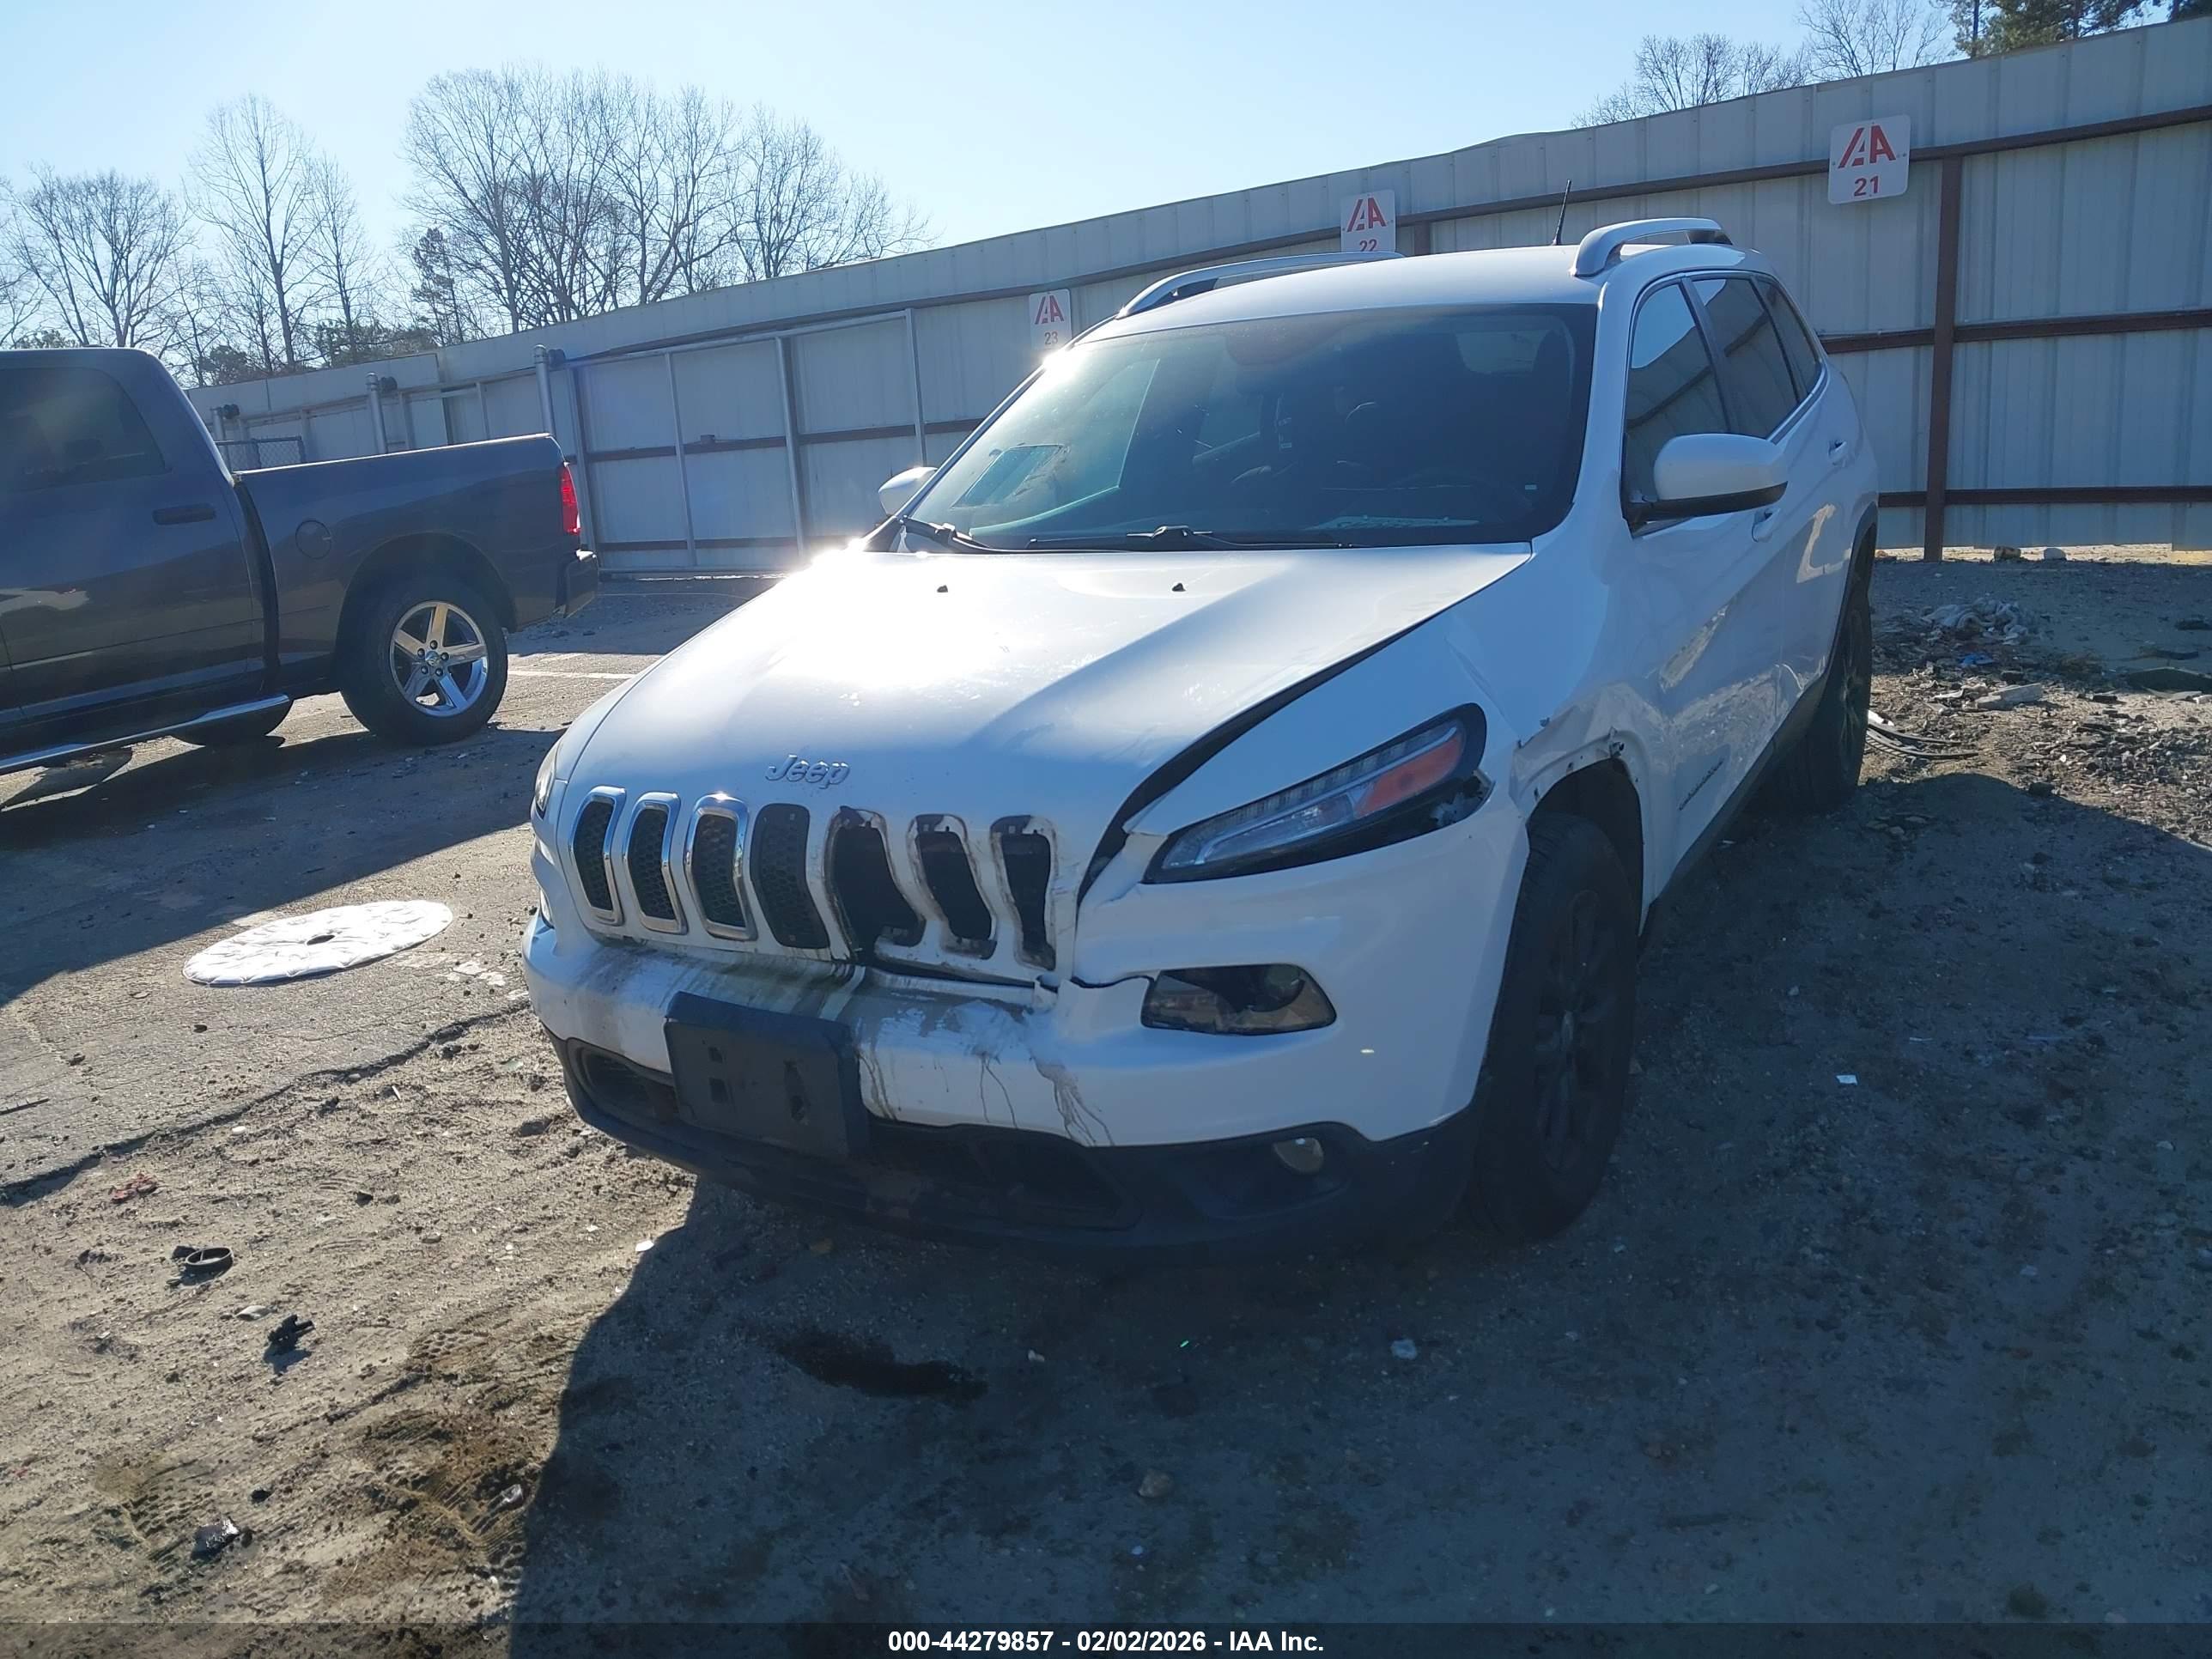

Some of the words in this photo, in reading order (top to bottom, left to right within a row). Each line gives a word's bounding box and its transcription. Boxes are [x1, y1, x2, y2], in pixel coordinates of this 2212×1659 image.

[1854, 176, 1879, 197] 21
[1359, 239, 1377, 252] 22
[1044, 331, 1059, 345] 23
[765, 754, 850, 790] Jeep
